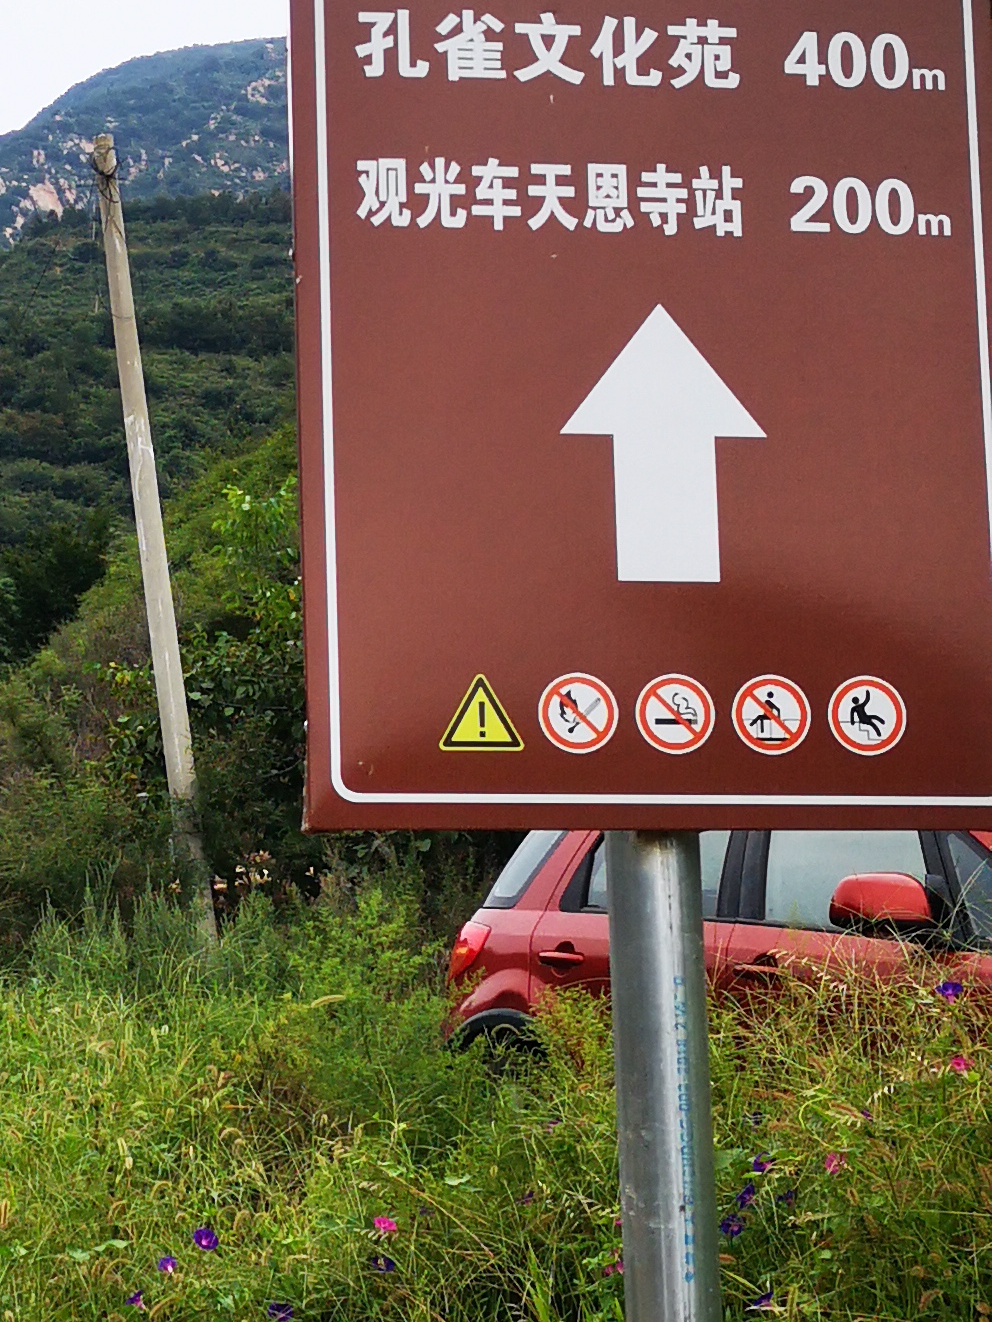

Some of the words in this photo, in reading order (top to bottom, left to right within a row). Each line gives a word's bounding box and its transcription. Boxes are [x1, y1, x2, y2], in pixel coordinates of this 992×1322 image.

[355, 10, 740, 89] 孔雀文化苑
[783, 32, 946, 89] 400m
[356, 158, 743, 236] 观光车天恩寺站
[789, 176, 952, 236] 200m
